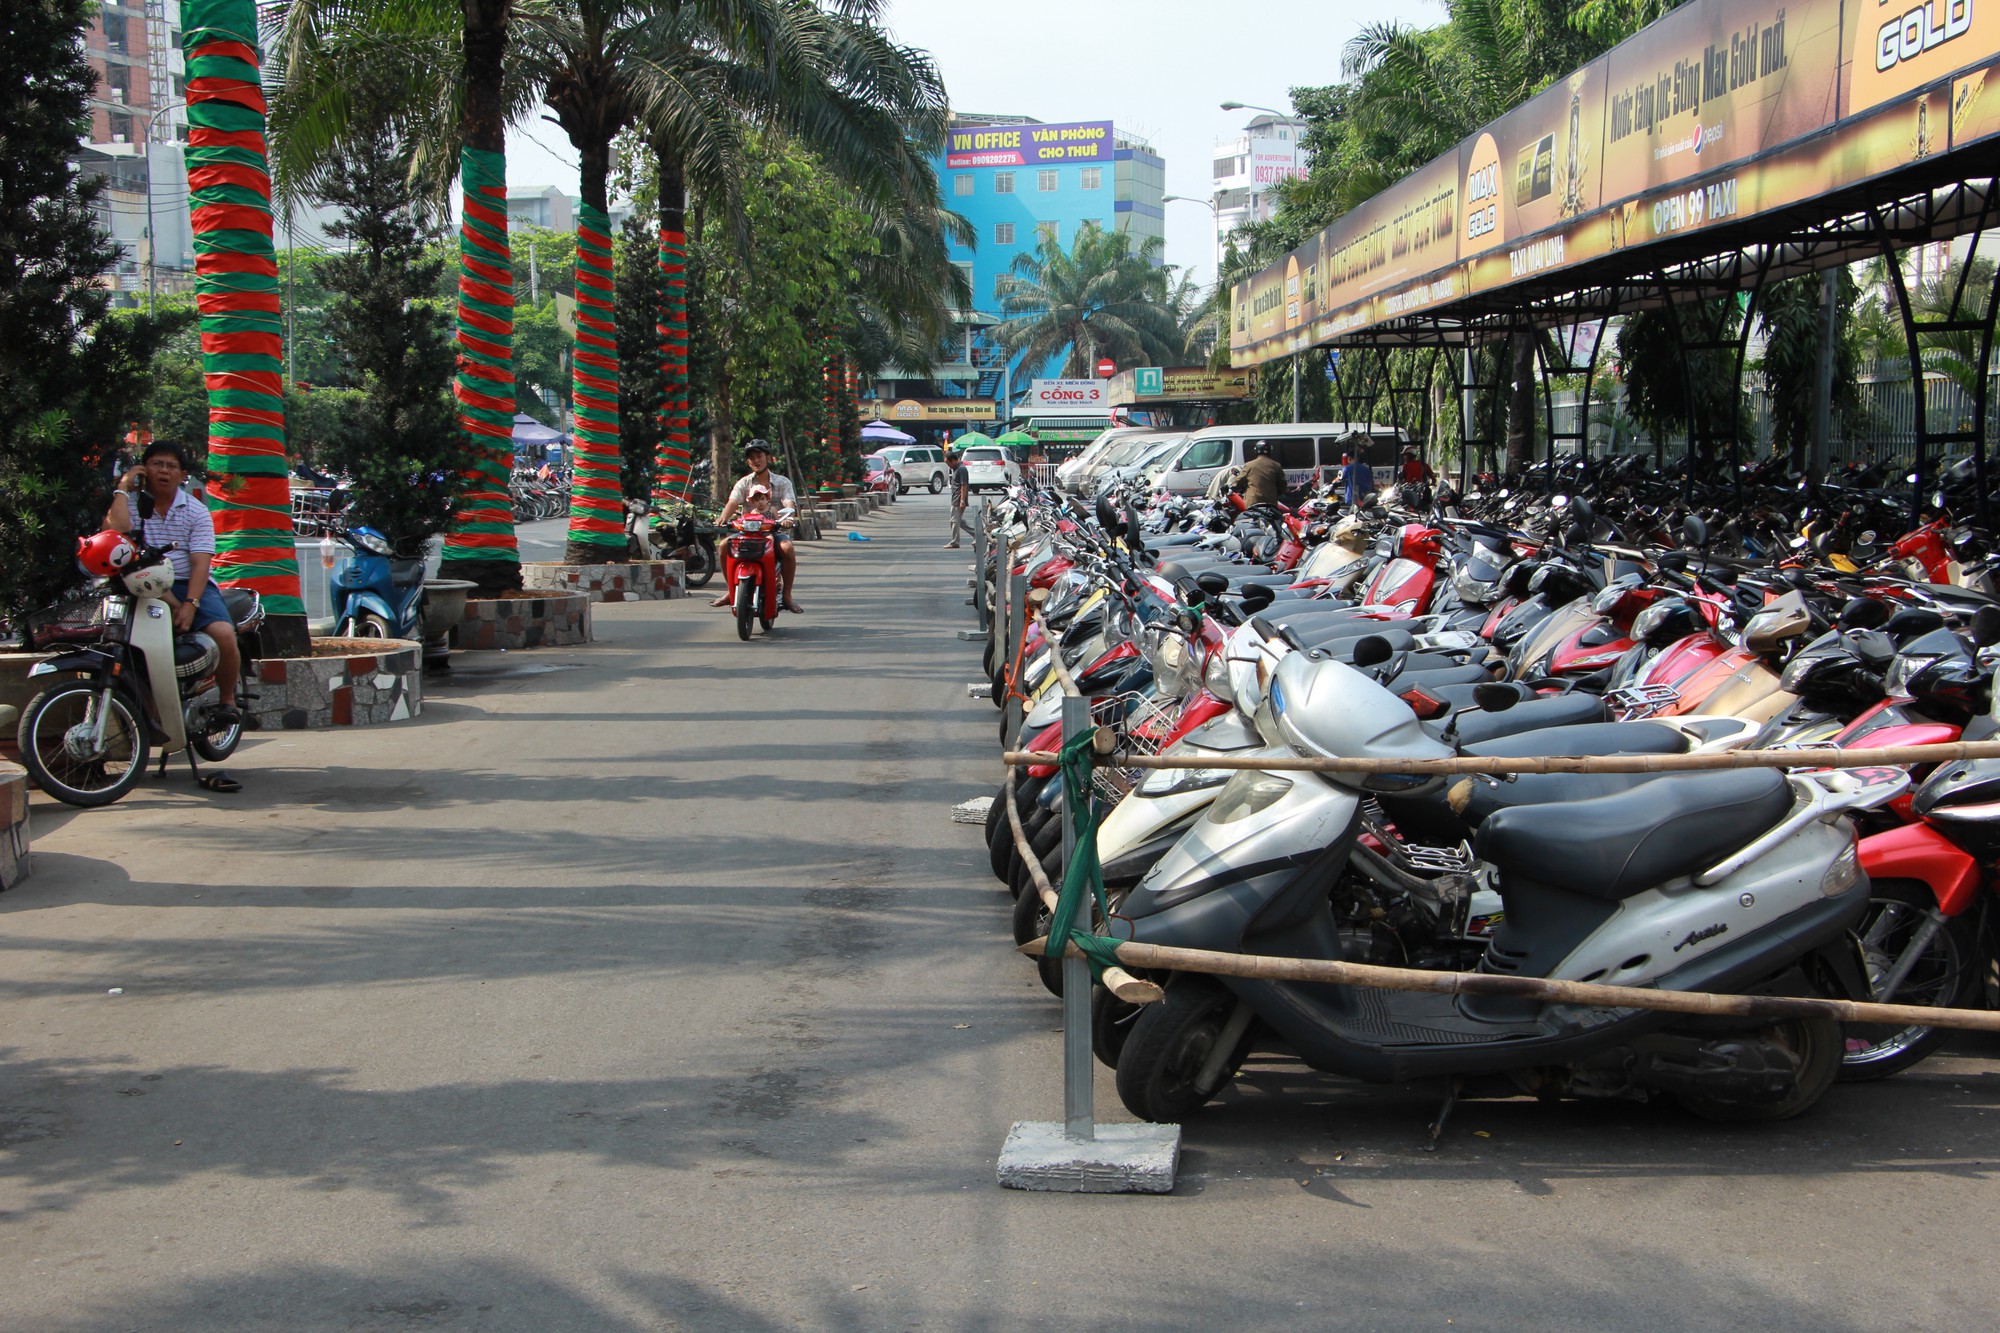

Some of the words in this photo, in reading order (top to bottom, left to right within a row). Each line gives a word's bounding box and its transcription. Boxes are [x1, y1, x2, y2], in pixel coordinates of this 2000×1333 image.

[1876, 0, 1973, 73] GOLD
[1610, 88, 1634, 143] Nước
[1634, 82, 1655, 136] tăng
[1656, 72, 1671, 134] lực
[1673, 58, 1700, 117] Sting
[1703, 44, 1728, 103] Max
[1730, 22, 1758, 91] Gold
[953, 134, 972, 150] VN
[975, 131, 1021, 149] OFFICE
[1032, 128, 1058, 142] VĂN
[1061, 126, 1105, 141] PHÒNG
[1702, 120, 1723, 149] pepsi
[1038, 146, 1065, 159] CHO
[1067, 143, 1098, 158] THUÊ
[1255, 165, 1273, 182] 0937
[1469, 160, 1498, 204] MAX
[1468, 203, 1496, 240] GOLD
[1653, 194, 1685, 234] OPEN
[1688, 188, 1704, 226] 99
[1707, 178, 1737, 220] TAXI
[1510, 247, 1527, 278] TAXI
[1528, 241, 1544, 272] MAI
[1545, 234, 1564, 268] LINH
[1040, 386, 1085, 400] CỔNG
[1089, 389, 1100, 400] 3
